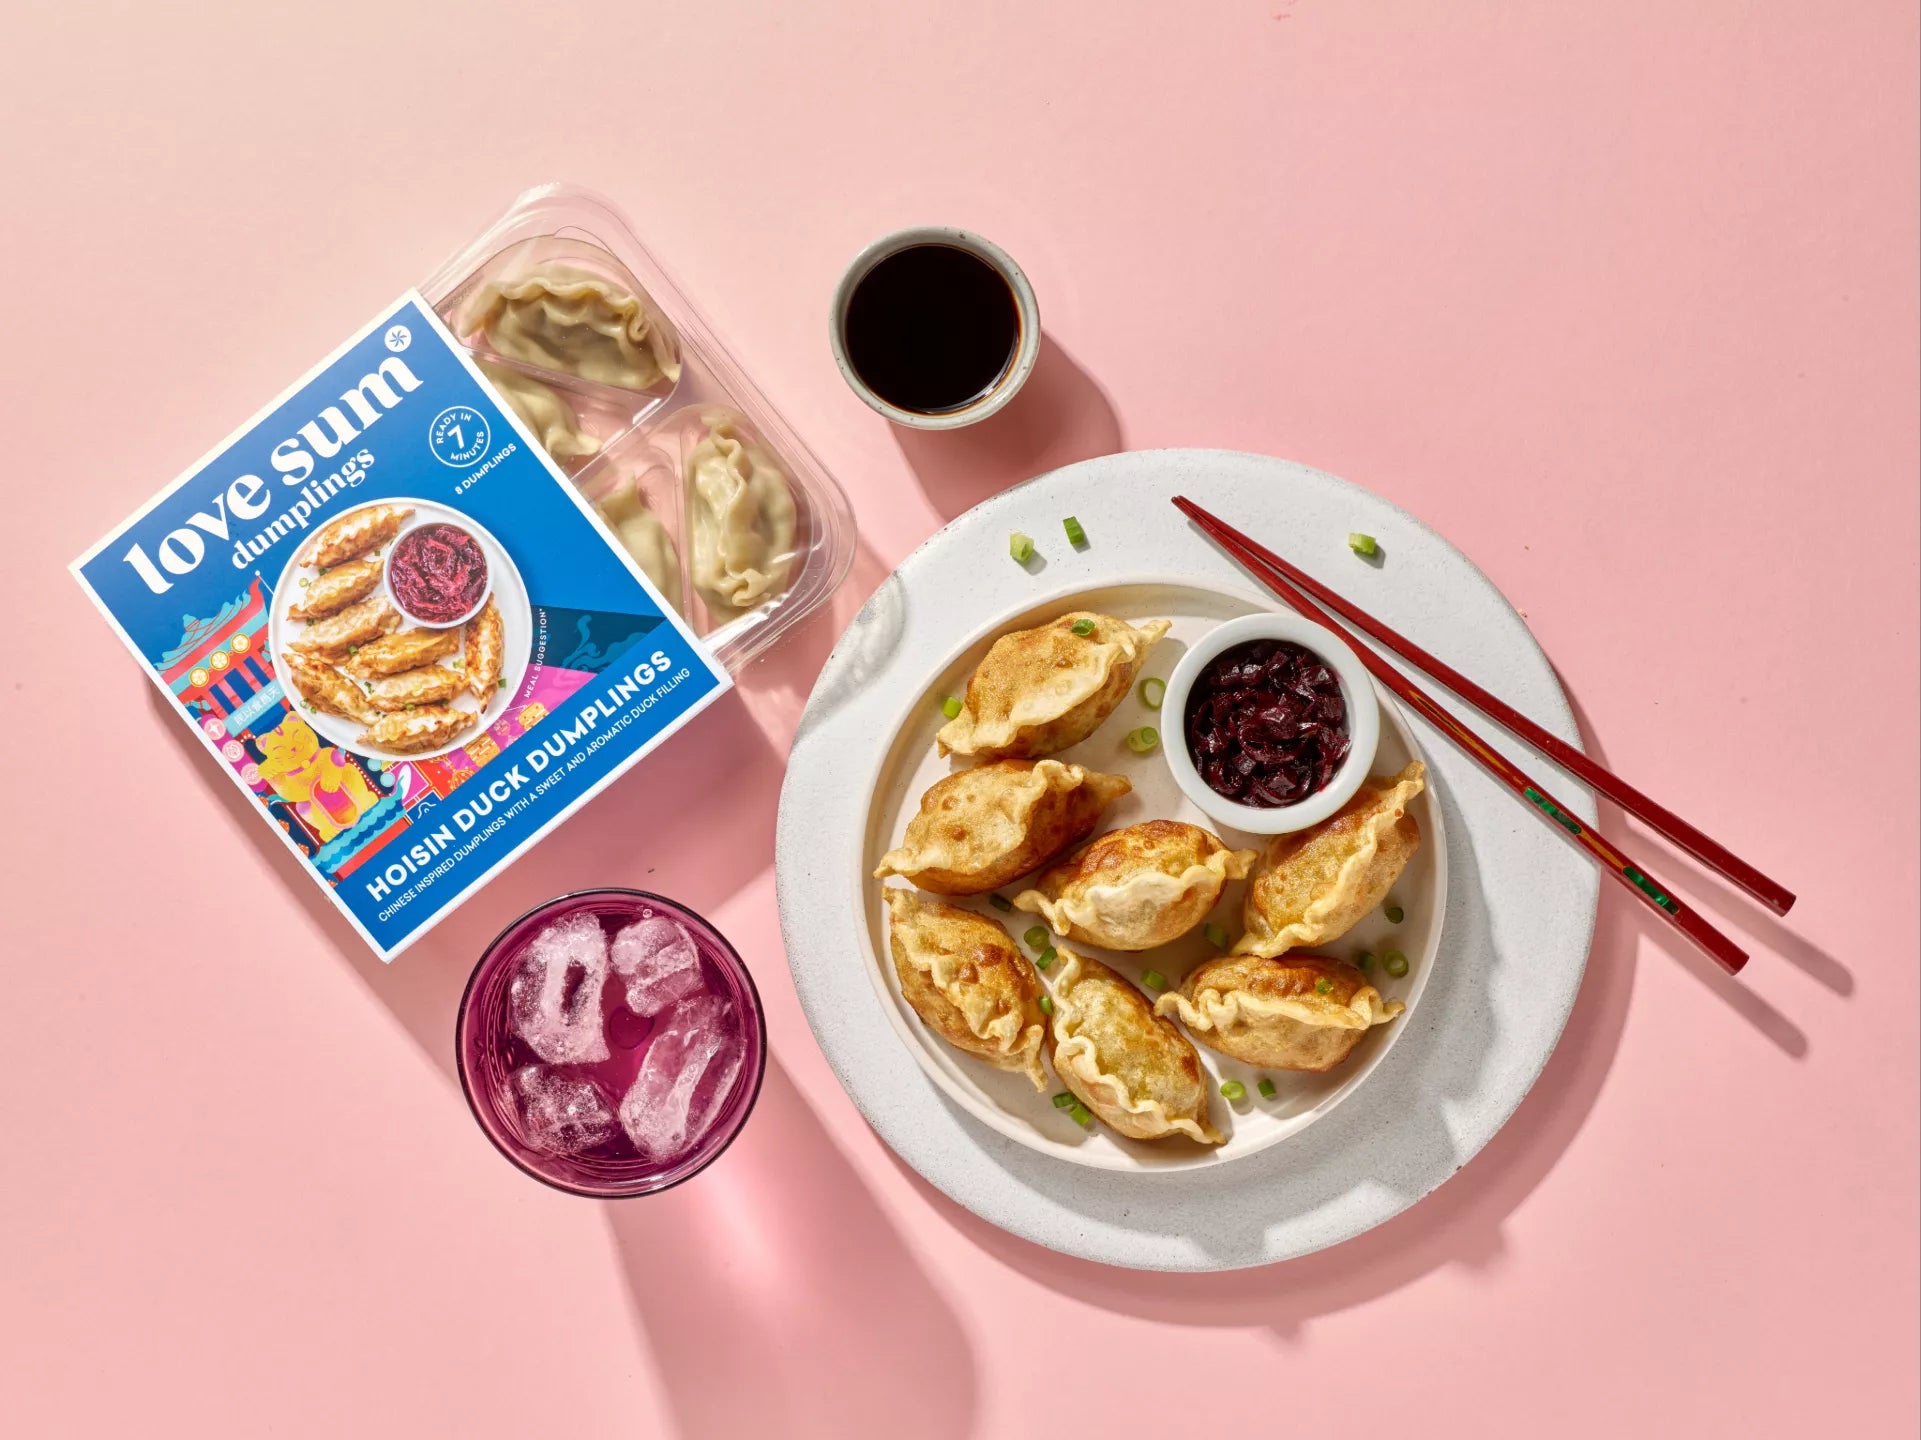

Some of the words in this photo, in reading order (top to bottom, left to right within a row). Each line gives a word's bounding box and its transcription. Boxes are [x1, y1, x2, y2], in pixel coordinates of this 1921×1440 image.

[436, 413, 457, 444] READY
[461, 413, 471, 421] IN
[447, 425, 464, 449] 7
[450, 431, 484, 460] MINUTES
[123, 474, 271, 594] love
[271, 356, 424, 486] sum
[455, 486, 463, 494] 8
[462, 443, 516, 489] DUMPLINGS
[232, 449, 375, 569] dumplings
[524, 676, 538, 698] MEAL
[366, 824, 456, 902] HOISIN
[452, 765, 530, 832] DUCK
[526, 651, 671, 773] DUMPLINGS
[378, 888, 417, 922] CHINESE
[414, 858, 455, 893] INSPIRED
[453, 817, 506, 861] DUMPLINGS
[504, 797, 530, 819] WITH
[529, 793, 538, 802] A
[535, 767, 565, 795] SWEET
[567, 752, 586, 772] AND
[586, 715, 632, 756] AROMATIC
[630, 694, 658, 719] DUCK
[656, 668, 690, 698] FILLING
